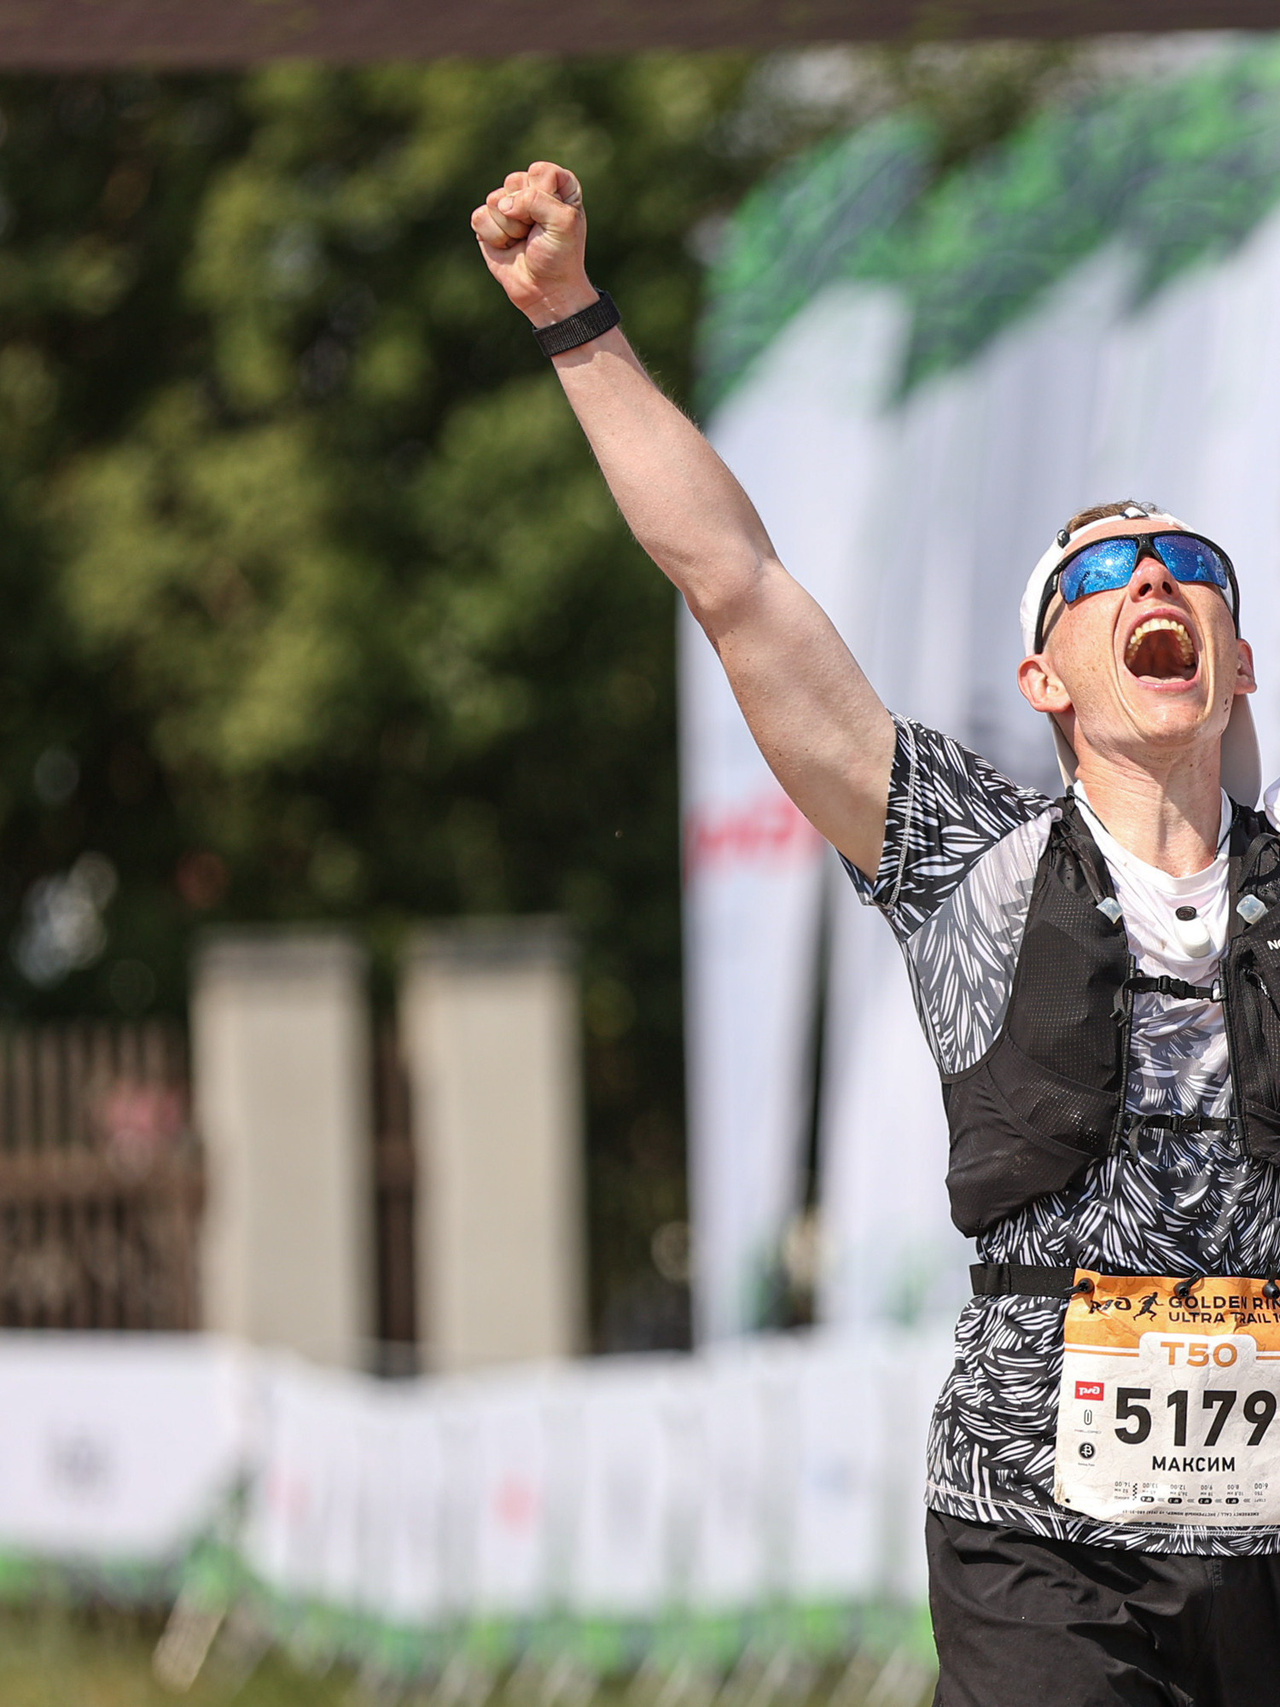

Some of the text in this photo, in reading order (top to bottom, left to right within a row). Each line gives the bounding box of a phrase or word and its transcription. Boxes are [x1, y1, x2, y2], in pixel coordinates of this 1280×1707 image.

[1169, 1312, 1225, 1323] ULTRA
[1230, 1312, 1271, 1324] TRAIL
[1160, 1342, 1238, 1368] T50
[1114, 1387, 1277, 1447] 5179
[1152, 1456, 1236, 1473] МАКСИМ
[1254, 1482, 1269, 1490] 6:00
